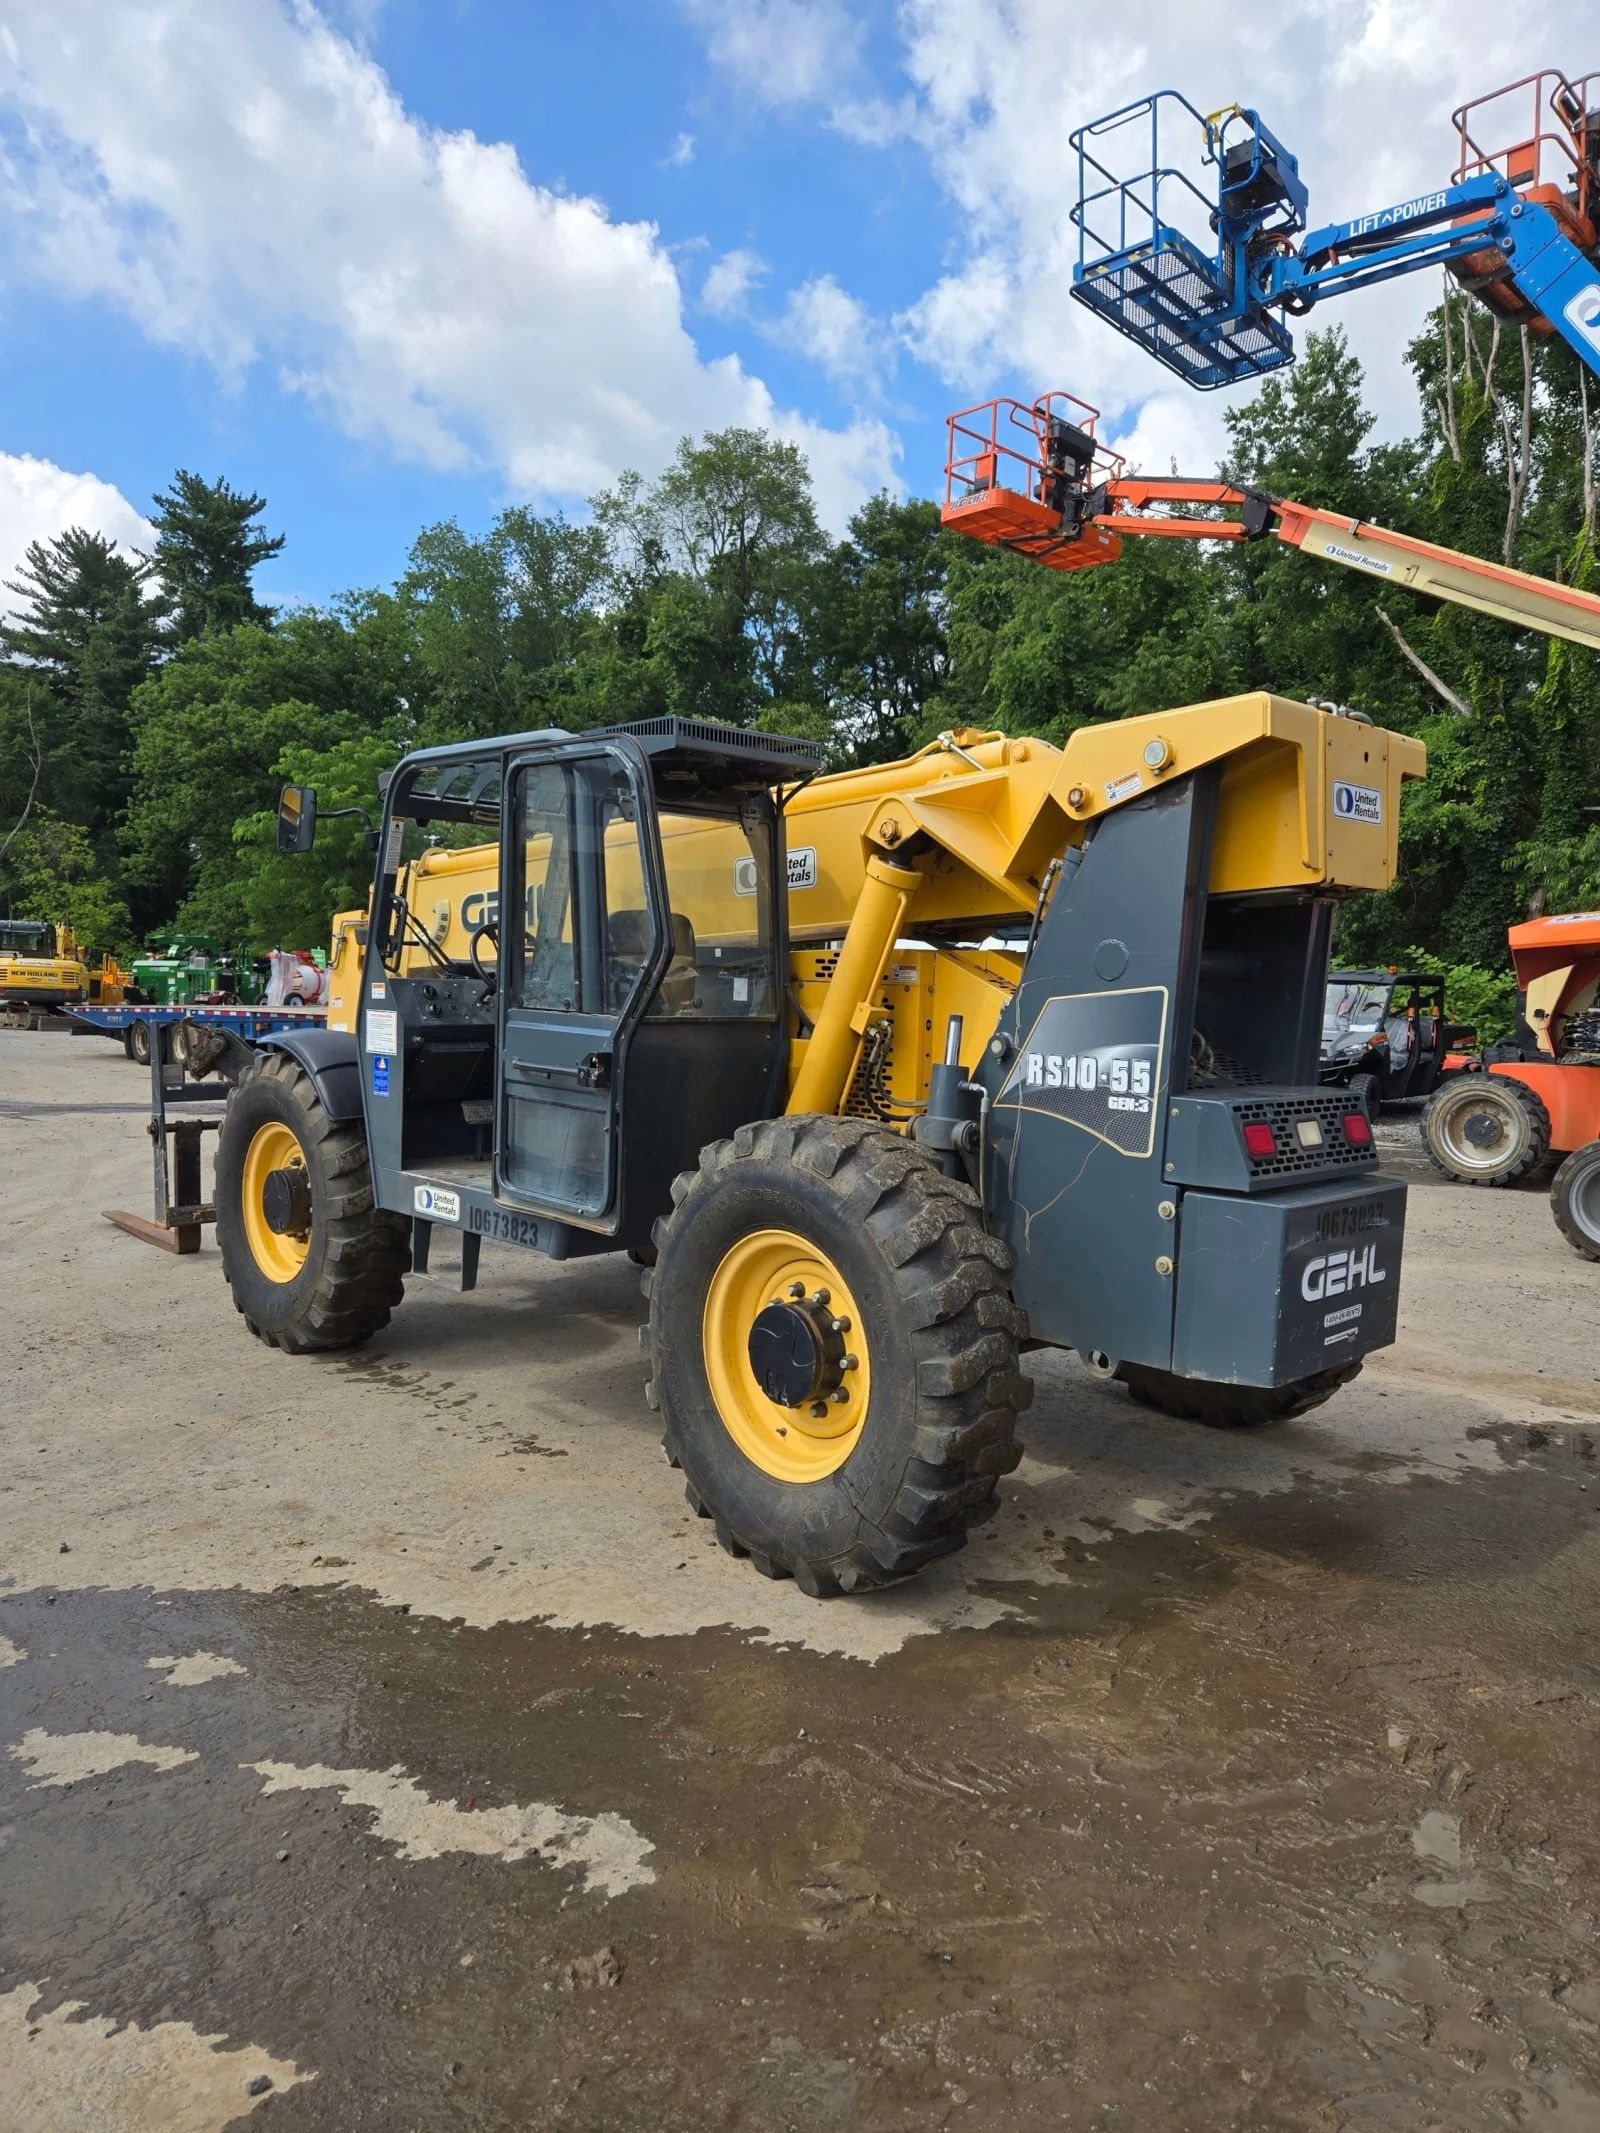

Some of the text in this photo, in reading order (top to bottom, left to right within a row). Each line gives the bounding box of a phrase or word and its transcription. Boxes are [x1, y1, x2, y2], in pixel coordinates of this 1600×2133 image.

[1350, 192, 1446, 237] LIFT POWER
[1336, 548, 1388, 572] United Rentals
[1355, 791, 1377, 806] United
[1354, 804, 1379, 819] Rentals
[27, 970, 58, 978] HOLLAND
[1026, 1052, 1151, 1095] RS10-55
[433, 1192, 455, 1206] United
[433, 1203, 457, 1217] Rentals
[468, 1205, 539, 1248] 10673823
[1301, 1243, 1387, 1302] GEHL
